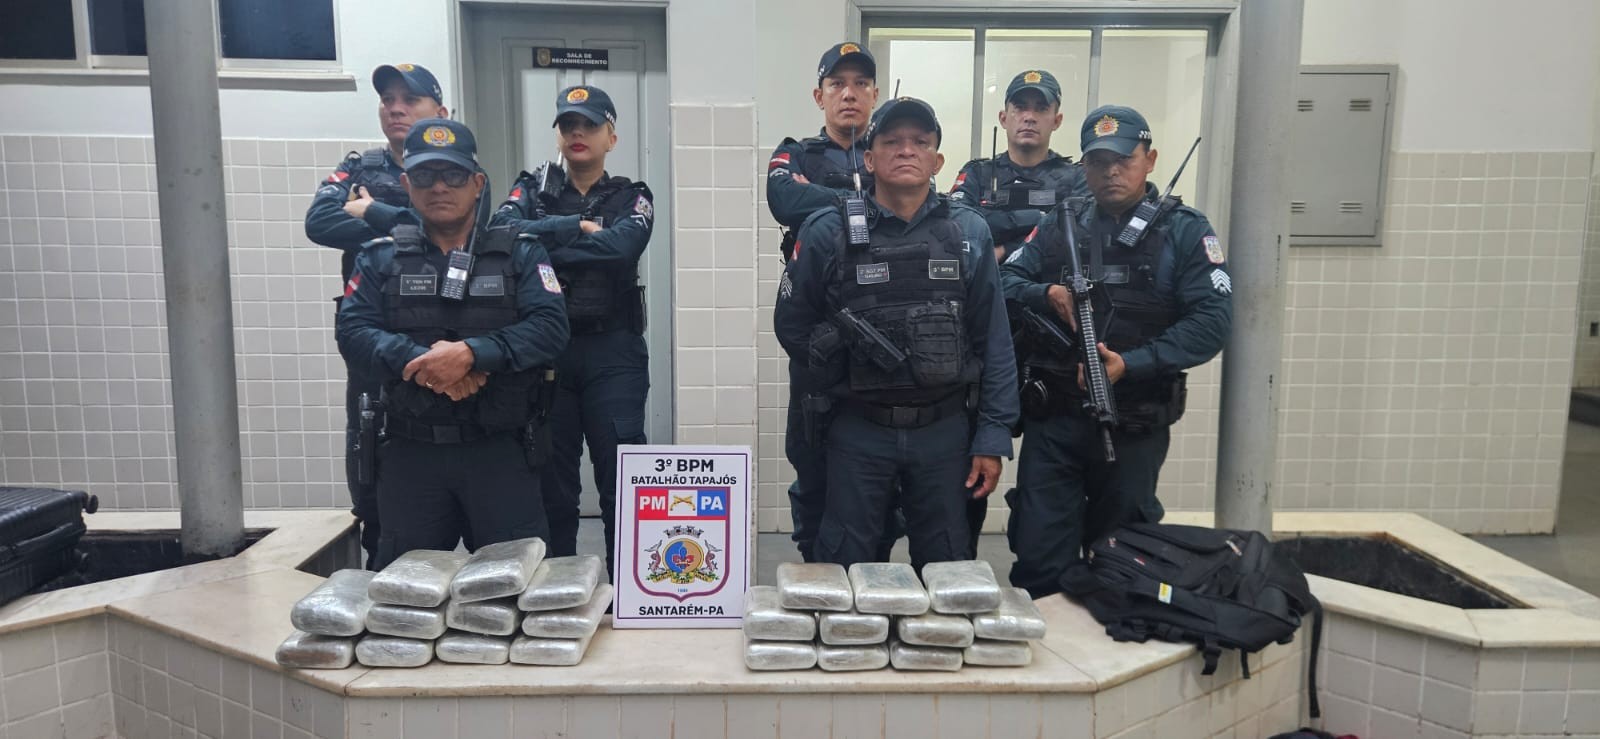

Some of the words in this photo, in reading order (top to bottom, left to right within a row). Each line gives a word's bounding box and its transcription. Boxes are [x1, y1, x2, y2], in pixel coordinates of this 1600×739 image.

[677, 459, 714, 472] BPM
[631, 474, 687, 485] BATALHÃO
[689, 474, 737, 485] TAPAJÓS
[639, 496, 666, 510] PM
[701, 496, 723, 510] PA
[638, 604, 724, 616] SANTARÉM-PA
